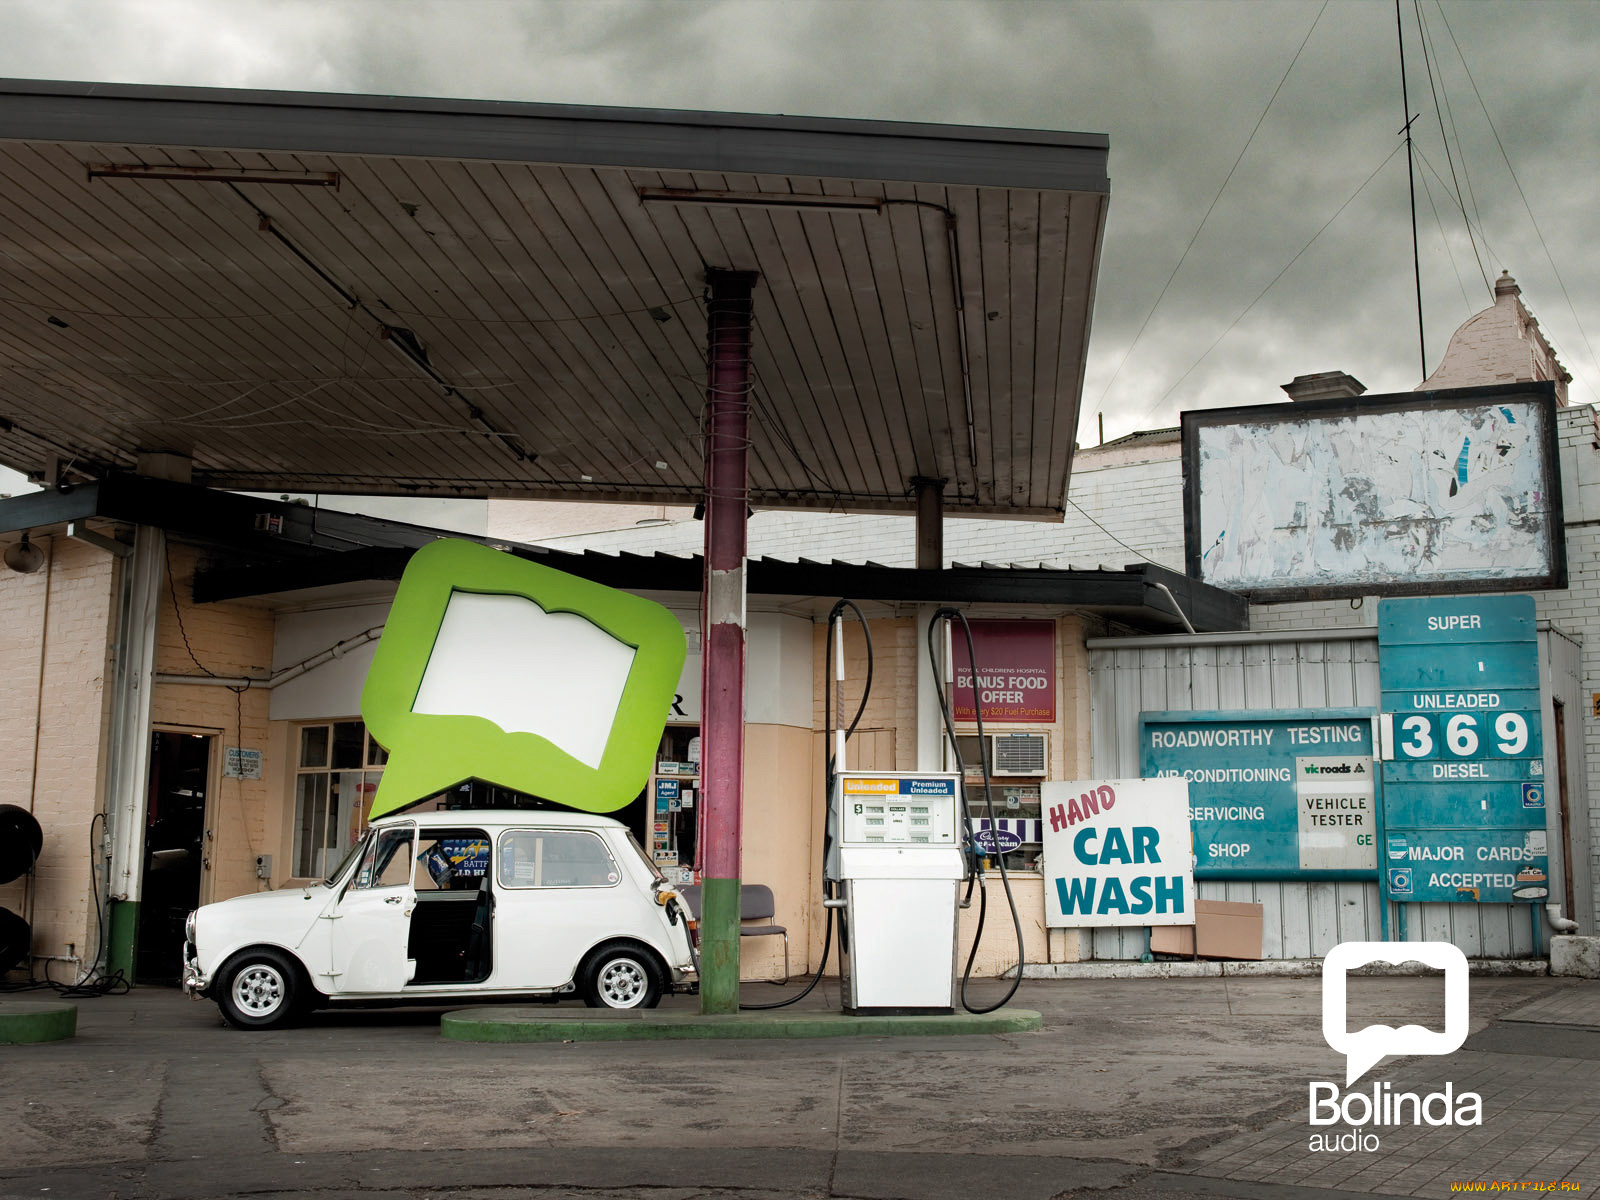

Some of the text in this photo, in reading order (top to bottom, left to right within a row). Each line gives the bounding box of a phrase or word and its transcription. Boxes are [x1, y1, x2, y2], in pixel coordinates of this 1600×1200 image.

[1427, 615, 1481, 631] SUPER
[957, 676, 1048, 690] BONUS FOOD
[981, 691, 1024, 704] OFFER
[1413, 693, 1500, 708] UNLEADED
[955, 706, 1050, 718] With eery $20 Fuel Purchase
[1151, 725, 1361, 748] ROADWORTHY TESTING
[1186, 768, 1291, 783] CONDITIONING
[1432, 764, 1489, 778] DIESEL
[846, 780, 897, 792] Unleaded
[1049, 784, 1116, 833] HAND
[1306, 798, 1367, 810] VEHICLE
[1187, 806, 1265, 821] SERVICING
[1311, 814, 1363, 826] TESTER
[1073, 826, 1162, 866] CAR
[1356, 834, 1373, 846] GE
[1208, 844, 1251, 857] SHOP
[1408, 846, 1534, 861] MAJOR CARDS
[1428, 873, 1516, 888] ACCEPTED
[1055, 876, 1185, 915] WASH
